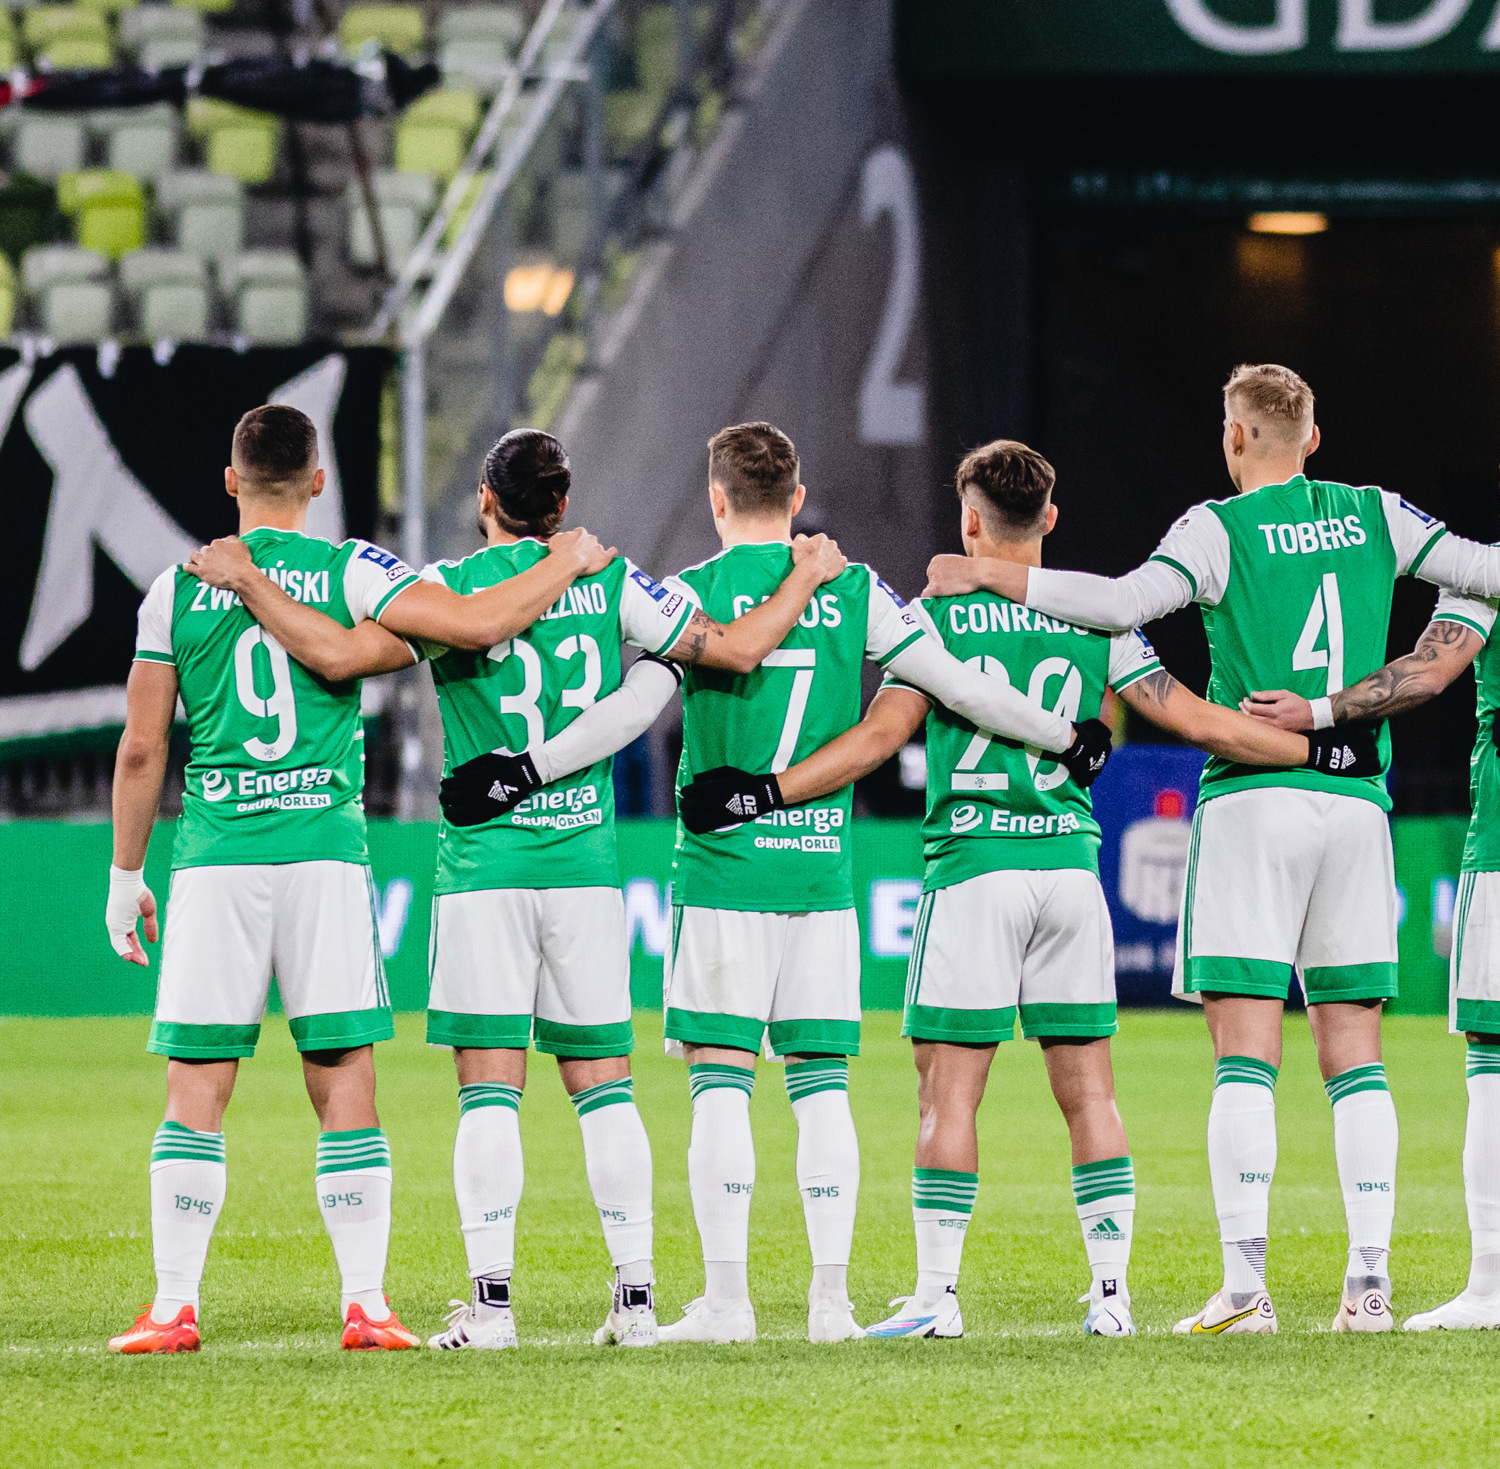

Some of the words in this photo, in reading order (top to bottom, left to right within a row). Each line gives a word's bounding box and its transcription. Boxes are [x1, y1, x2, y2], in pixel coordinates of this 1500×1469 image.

[1258, 515, 1366, 555] TOBERS
[190, 560, 329, 611] ZWŃSKI
[733, 594, 842, 628] GOS
[950, 602, 1090, 635] CONRA
[1292, 572, 1344, 697] 4
[234, 624, 297, 761] 9
[487, 634, 602, 757] 33
[761, 649, 816, 775] 7
[238, 768, 333, 795] Energa
[236, 797, 281, 812] GRUPA
[283, 795, 327, 807] ORLEN
[514, 785, 597, 813] Energa
[511, 814, 556, 828] GRUPA
[558, 811, 599, 827] ORLEN
[754, 808, 844, 833] Energa
[990, 809, 1080, 835] Energa
[754, 836, 801, 849] GRUPA
[1239, 1172, 1271, 1183] 1945
[1356, 1182, 1391, 1192] 1945
[322, 1192, 363, 1208] 1945
[808, 1186, 839, 1198] 1945
[175, 1195, 214, 1215] 1945
[484, 1206, 513, 1222] 1945
[1087, 1231, 1125, 1241] adidas
